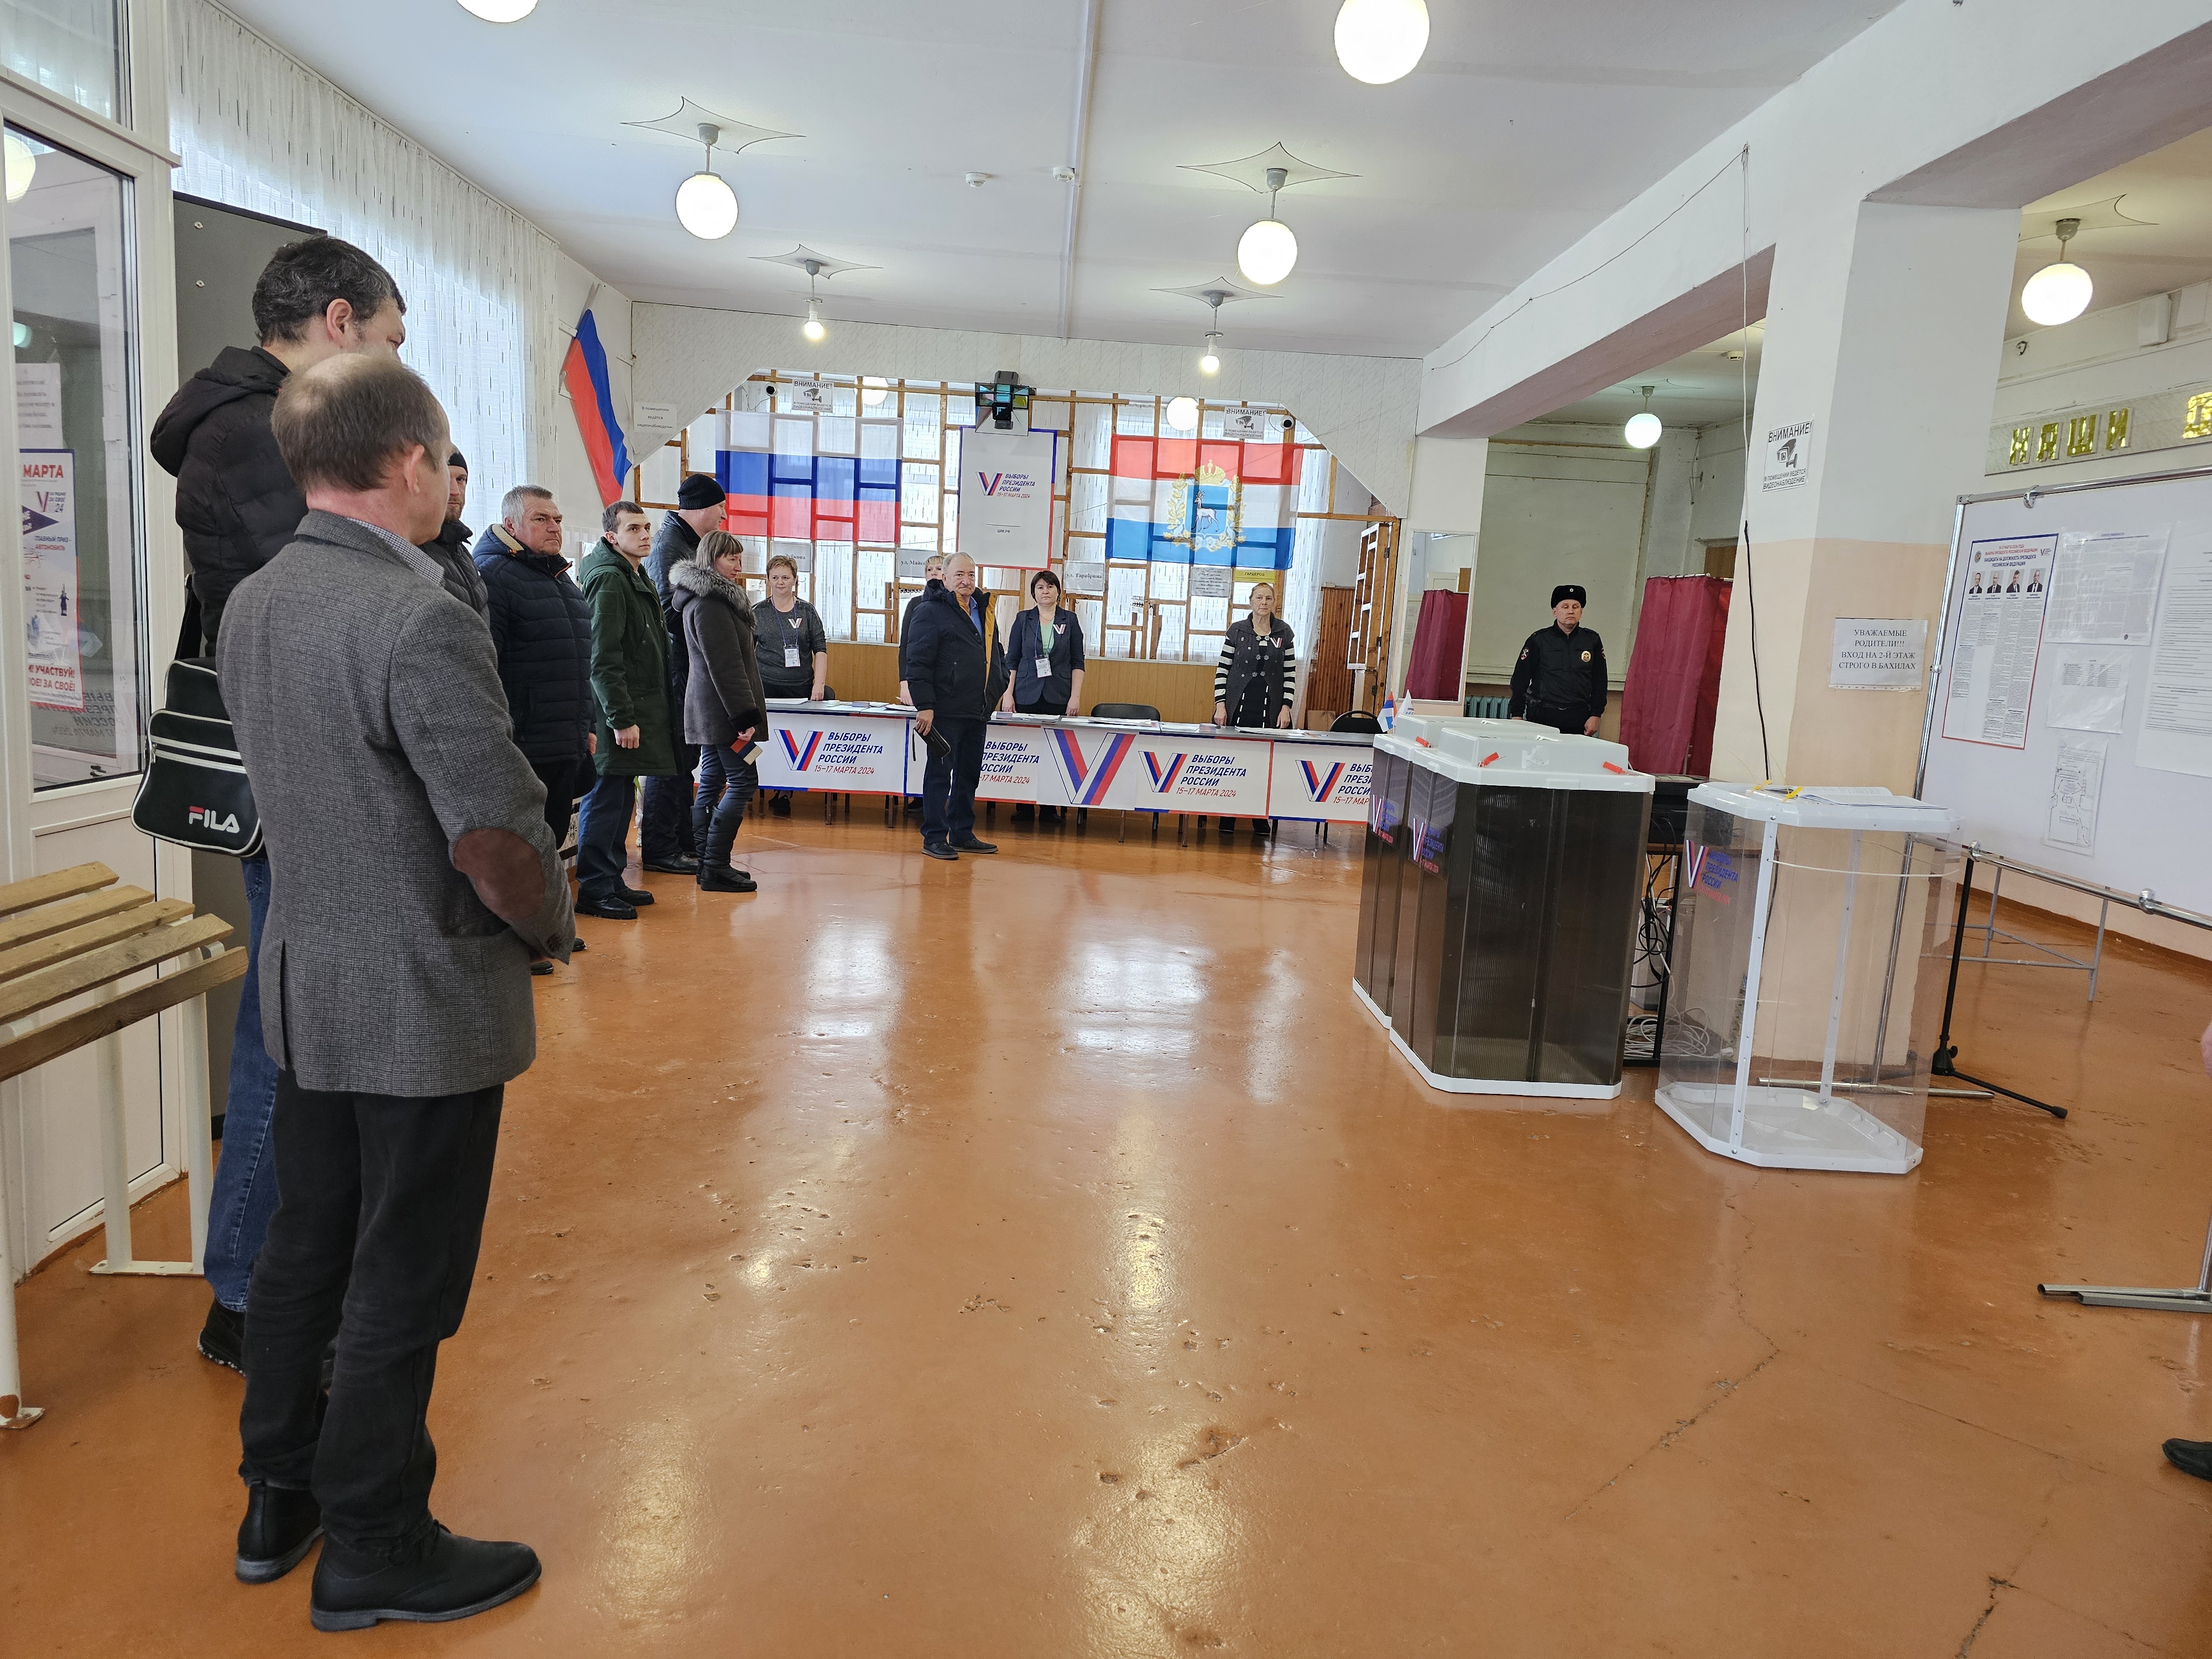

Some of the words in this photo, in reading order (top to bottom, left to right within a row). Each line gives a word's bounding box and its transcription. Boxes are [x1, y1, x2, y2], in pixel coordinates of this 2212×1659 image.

[1768, 422, 1812, 442] ВНИМАНИЕ!
[2009, 408, 2132, 465] НАШИ
[23, 465, 64, 478] МАРТА
[1767, 472, 1790, 481] ПОМЕЩЕНИИ
[1763, 476, 1805, 489] ВИДЕОНАБЛЮДЕНИЕ
[35, 665, 75, 678] УЧАСТВУЙ!
[43, 679, 53, 688] ЗА
[55, 680, 75, 691] СВОЁ!
[828, 732, 871, 742] ВЫБОРЫ
[823, 743, 883, 754] ПРЕЗИДЕНТА
[985, 741, 1028, 752] ВЫБОРЫ
[818, 754, 857, 764] РОССИИ
[983, 753, 1040, 763] ПРЕЗИДЕНТА
[1192, 754, 1235, 765] ВЫБОРЫ
[981, 764, 1013, 773] ОССИИ
[1186, 765, 1247, 777] ПРЕЗИДЕНТА
[1350, 763, 1373, 772] ВЫБ
[1181, 776, 1220, 786] РОССИИ
[1196, 788, 1219, 796] МАРТА
[1219, 789, 1237, 797] 2024
[1338, 785, 1371, 795] РОССИ
[189, 806, 239, 833] FILA
[1705, 862, 1739, 882] ПРЕЗИДЕНТА
[1702, 873, 1723, 890] РОССИИ
